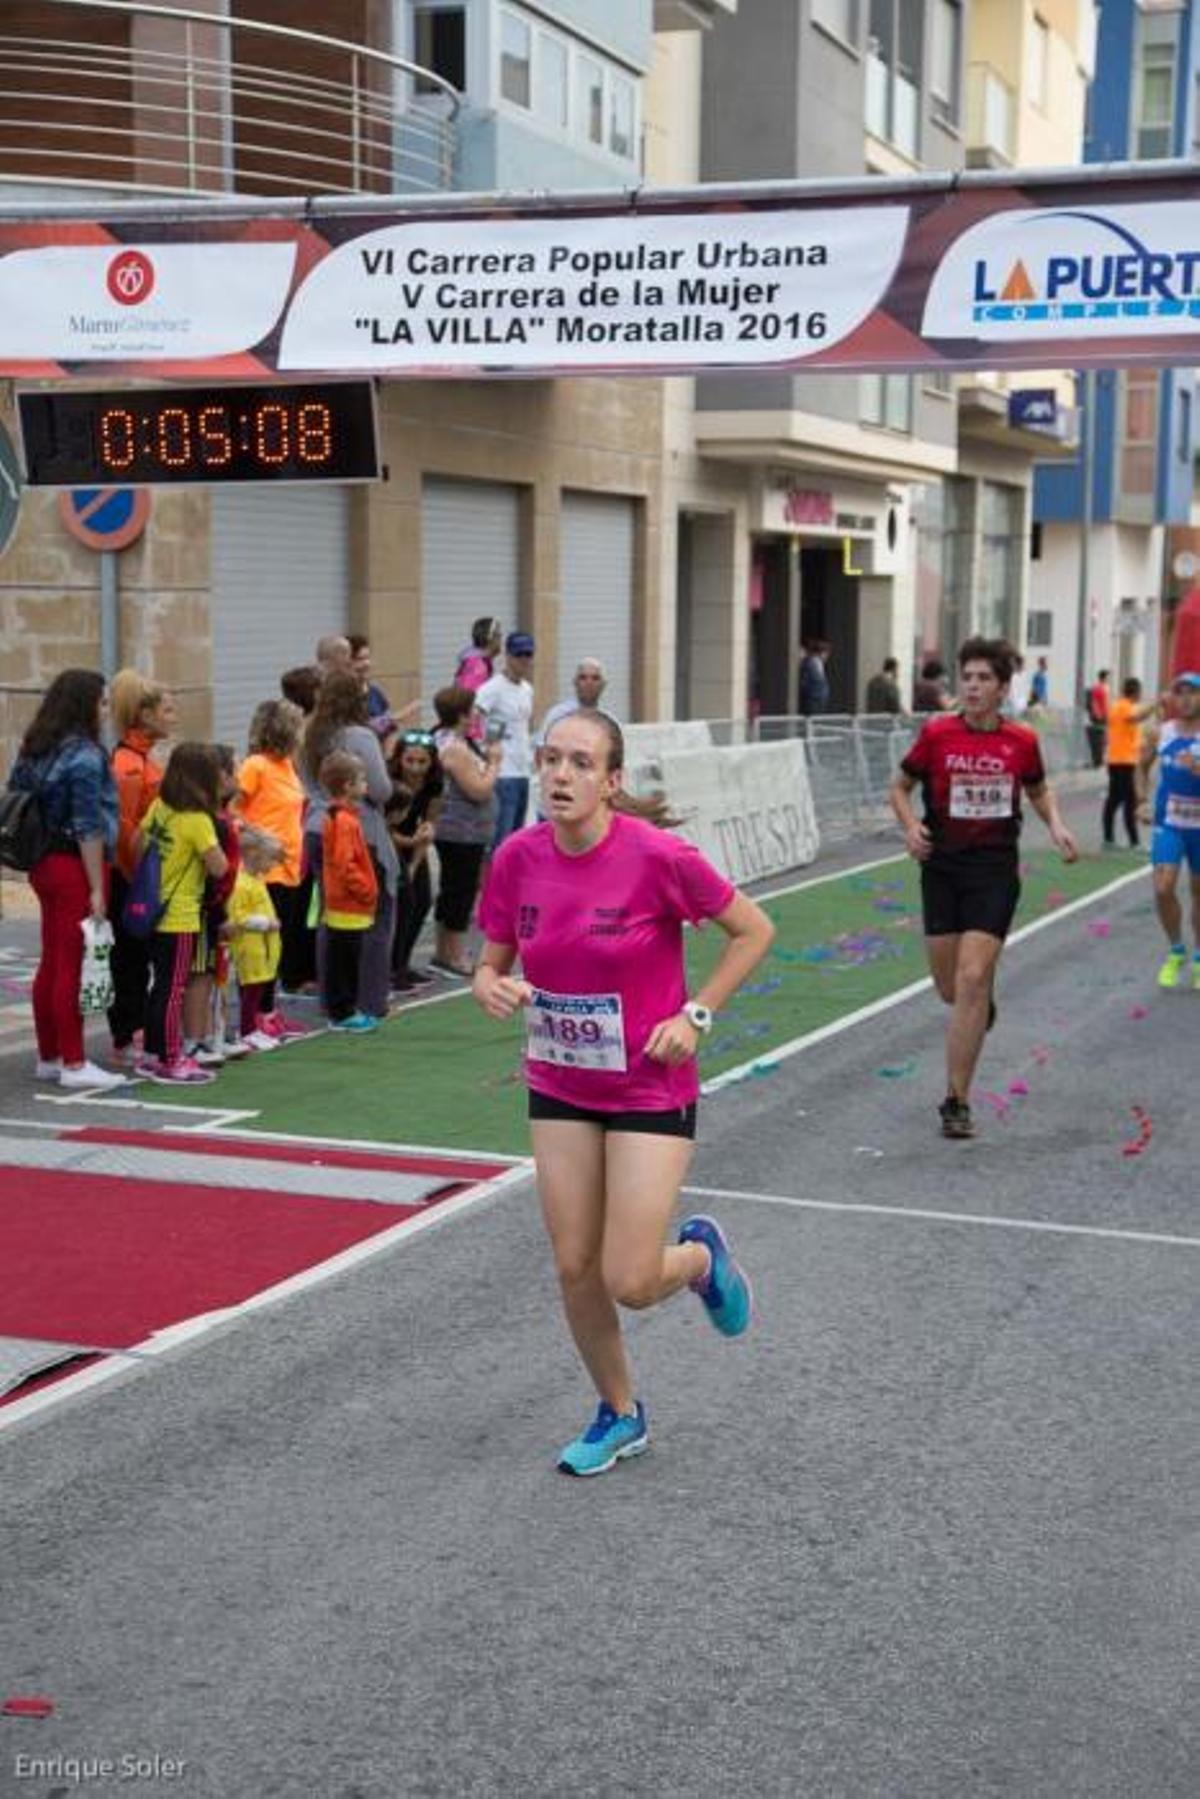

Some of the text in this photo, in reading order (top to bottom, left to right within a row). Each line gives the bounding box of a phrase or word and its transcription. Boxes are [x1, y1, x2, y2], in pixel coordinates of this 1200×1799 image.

[361, 242, 828, 278] VI Carrera Popular Urbana
[402, 277, 780, 312] V Carrera de la Mujer
[355, 312, 827, 344] "LA VILLA" Moratalla 2016
[101, 403, 332, 466] 0:05:08
[541, 1012, 600, 1044] 189
